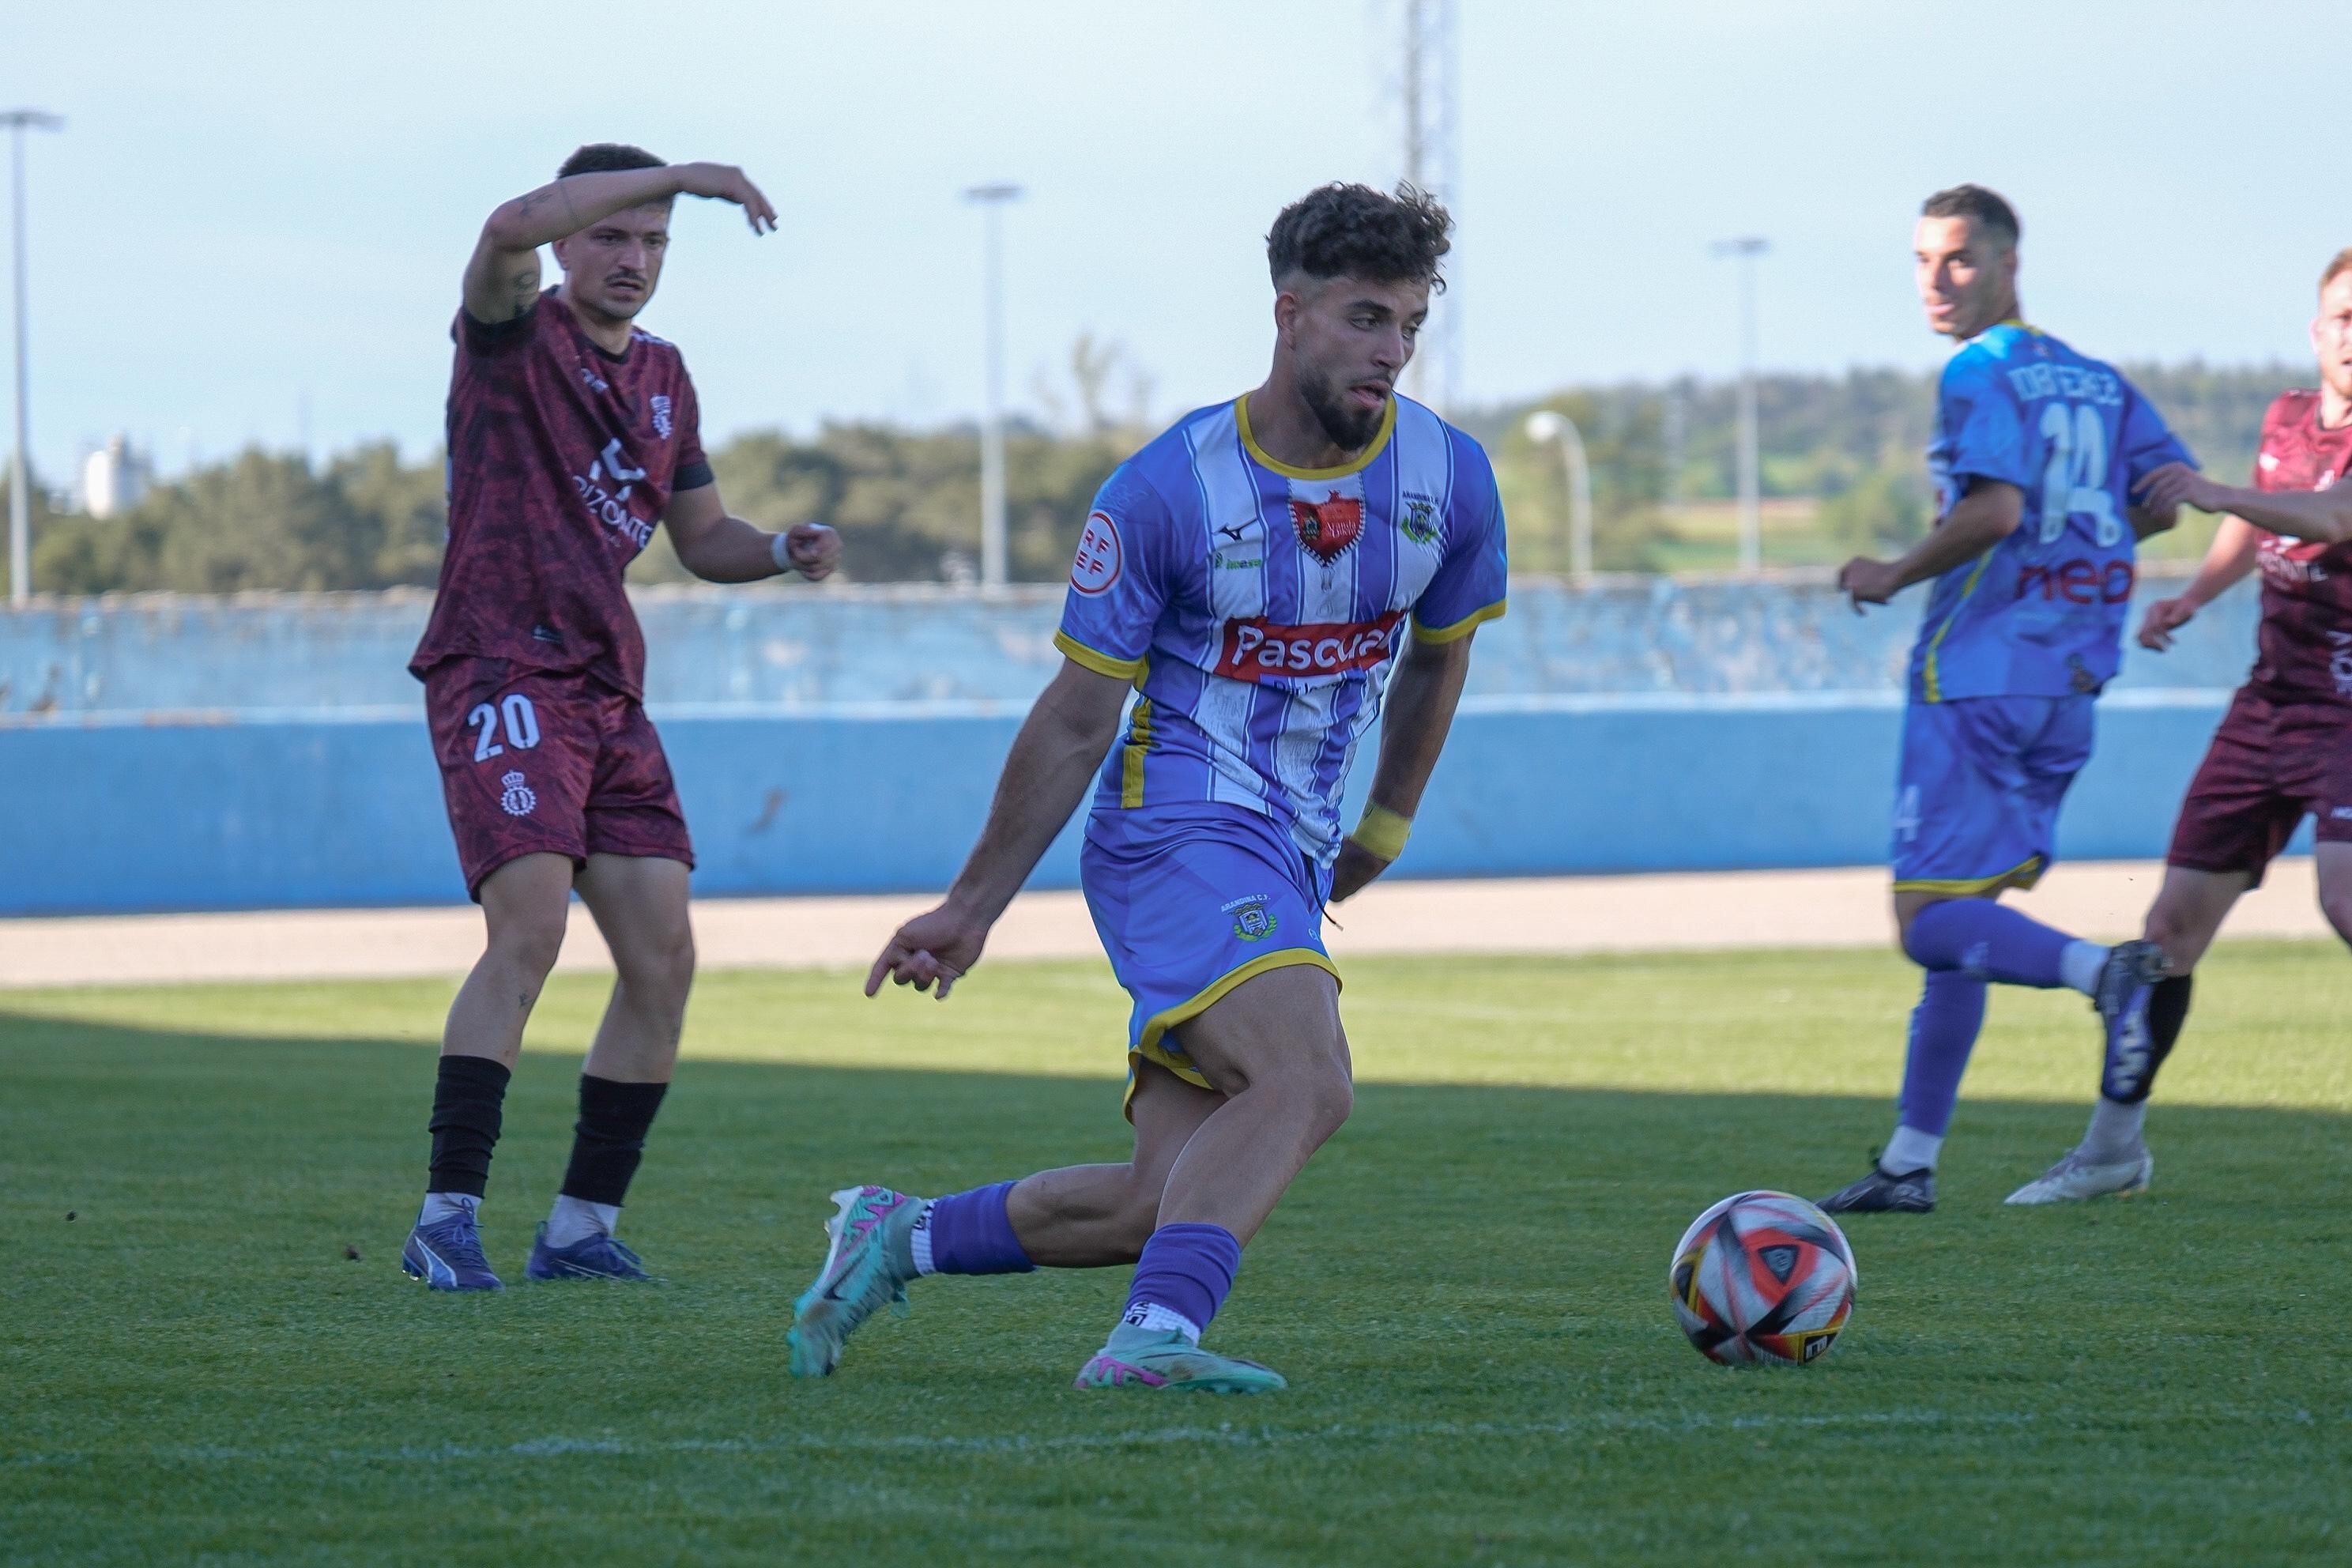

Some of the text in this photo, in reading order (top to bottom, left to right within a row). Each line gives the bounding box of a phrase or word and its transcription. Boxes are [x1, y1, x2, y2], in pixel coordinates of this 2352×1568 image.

[2038, 403, 2124, 548] 14
[1076, 549, 1106, 575] EF
[1083, 527, 1112, 553] RF
[467, 693, 541, 763] 20
